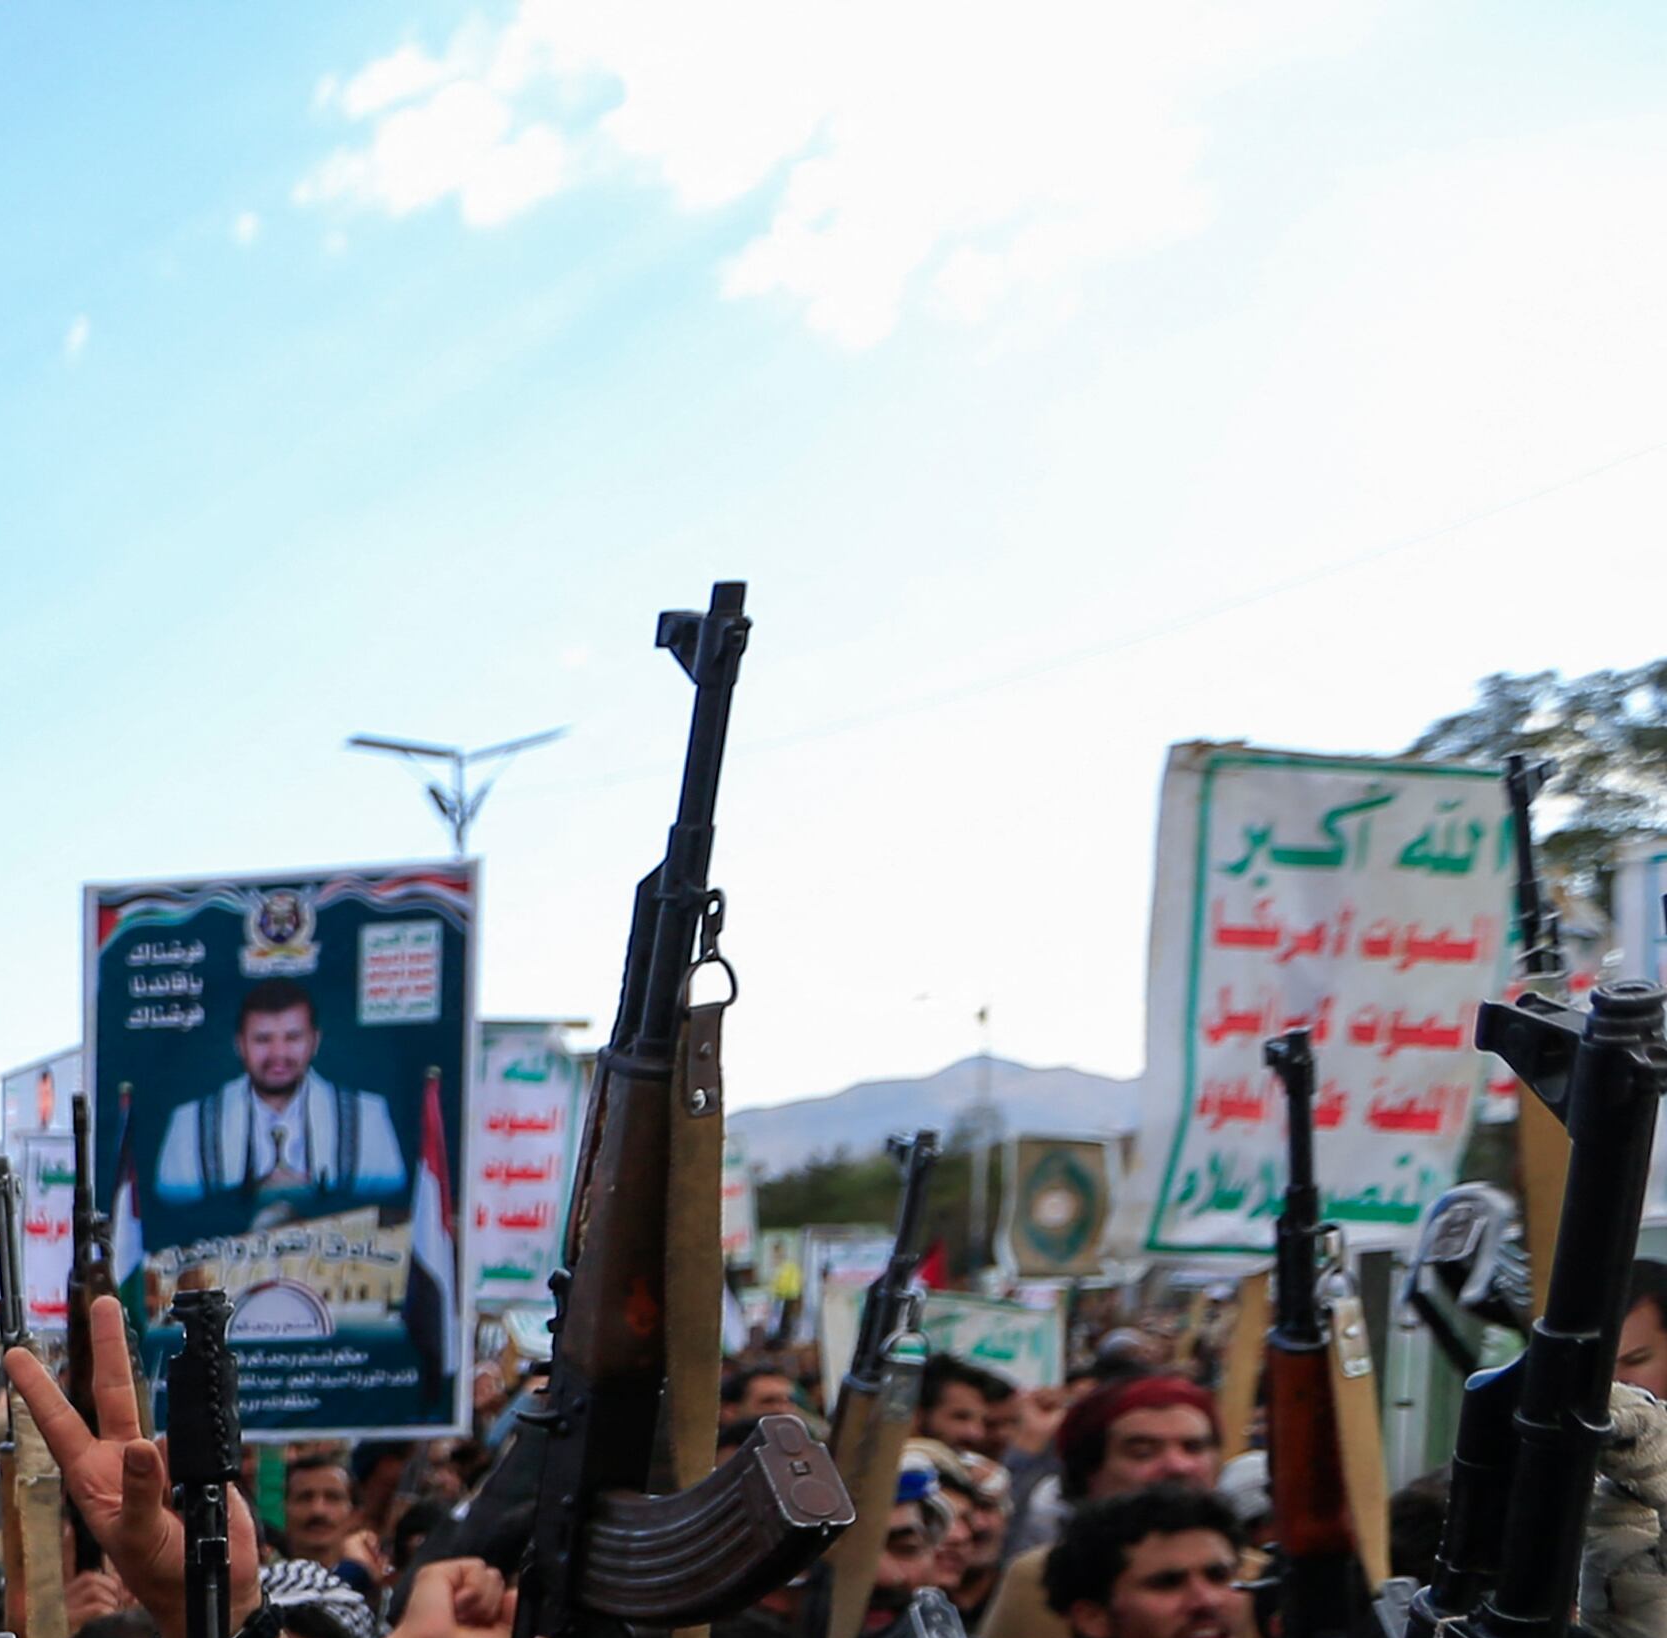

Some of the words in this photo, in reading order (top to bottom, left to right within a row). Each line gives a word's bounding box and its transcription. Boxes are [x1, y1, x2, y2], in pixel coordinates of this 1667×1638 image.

[1220, 781, 1397, 887] أكبر
[1394, 800, 1515, 876] الله
[1359, 914, 1499, 974] الموت
